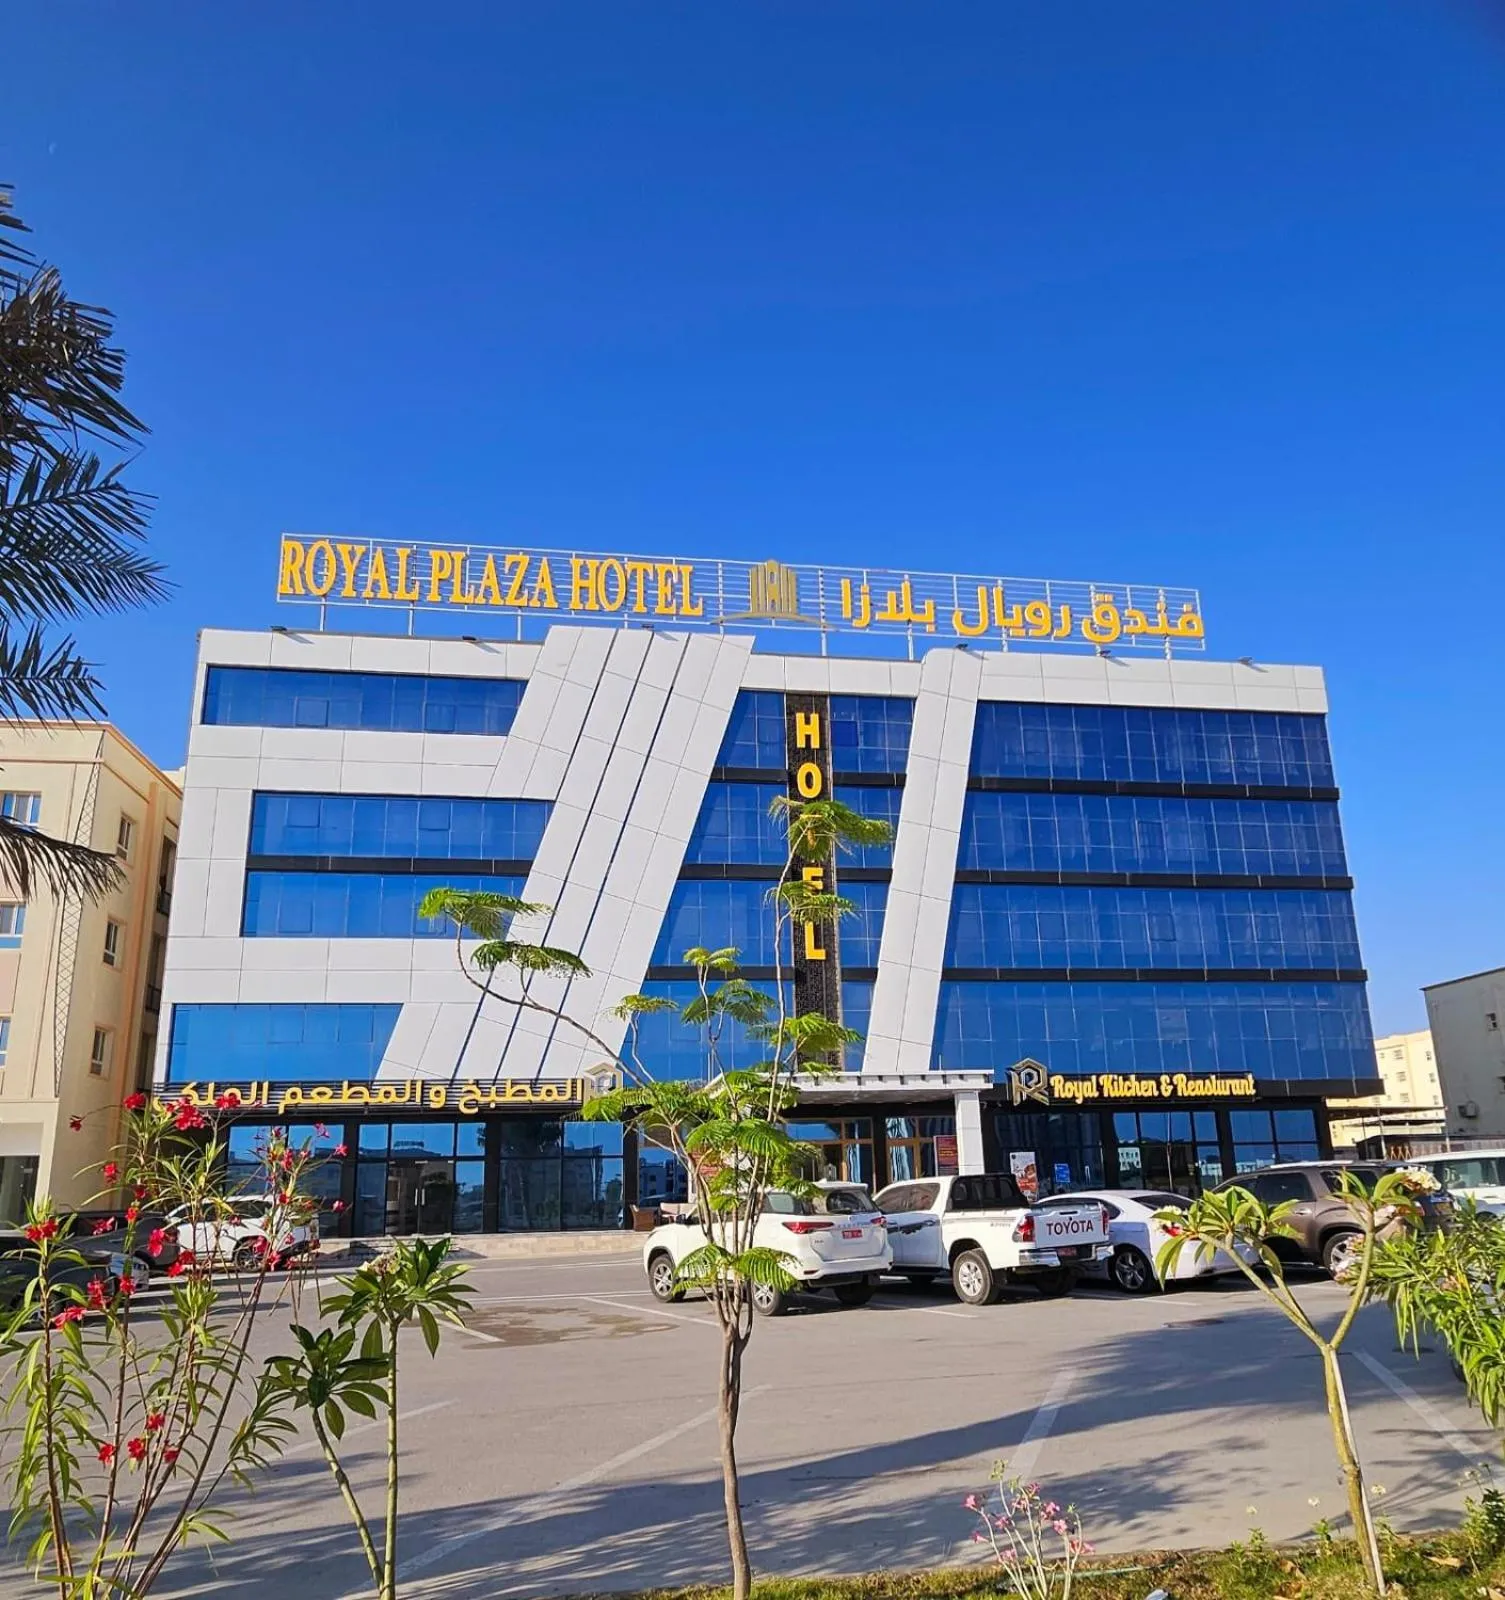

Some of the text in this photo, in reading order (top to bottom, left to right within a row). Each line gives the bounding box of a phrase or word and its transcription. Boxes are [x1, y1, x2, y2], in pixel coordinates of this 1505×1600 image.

[278, 540, 703, 616] ROYAL PLAZA HOTEL
[840, 577, 1205, 644] فندق رويال بلازا
[458, 1078, 583, 1114] المطبخ
[1050, 1074, 1099, 1104] Royal
[1100, 1073, 1159, 1098] Kitchen
[1160, 1074, 1173, 1098] &
[1046, 1219, 1094, 1236] TOYOTA
